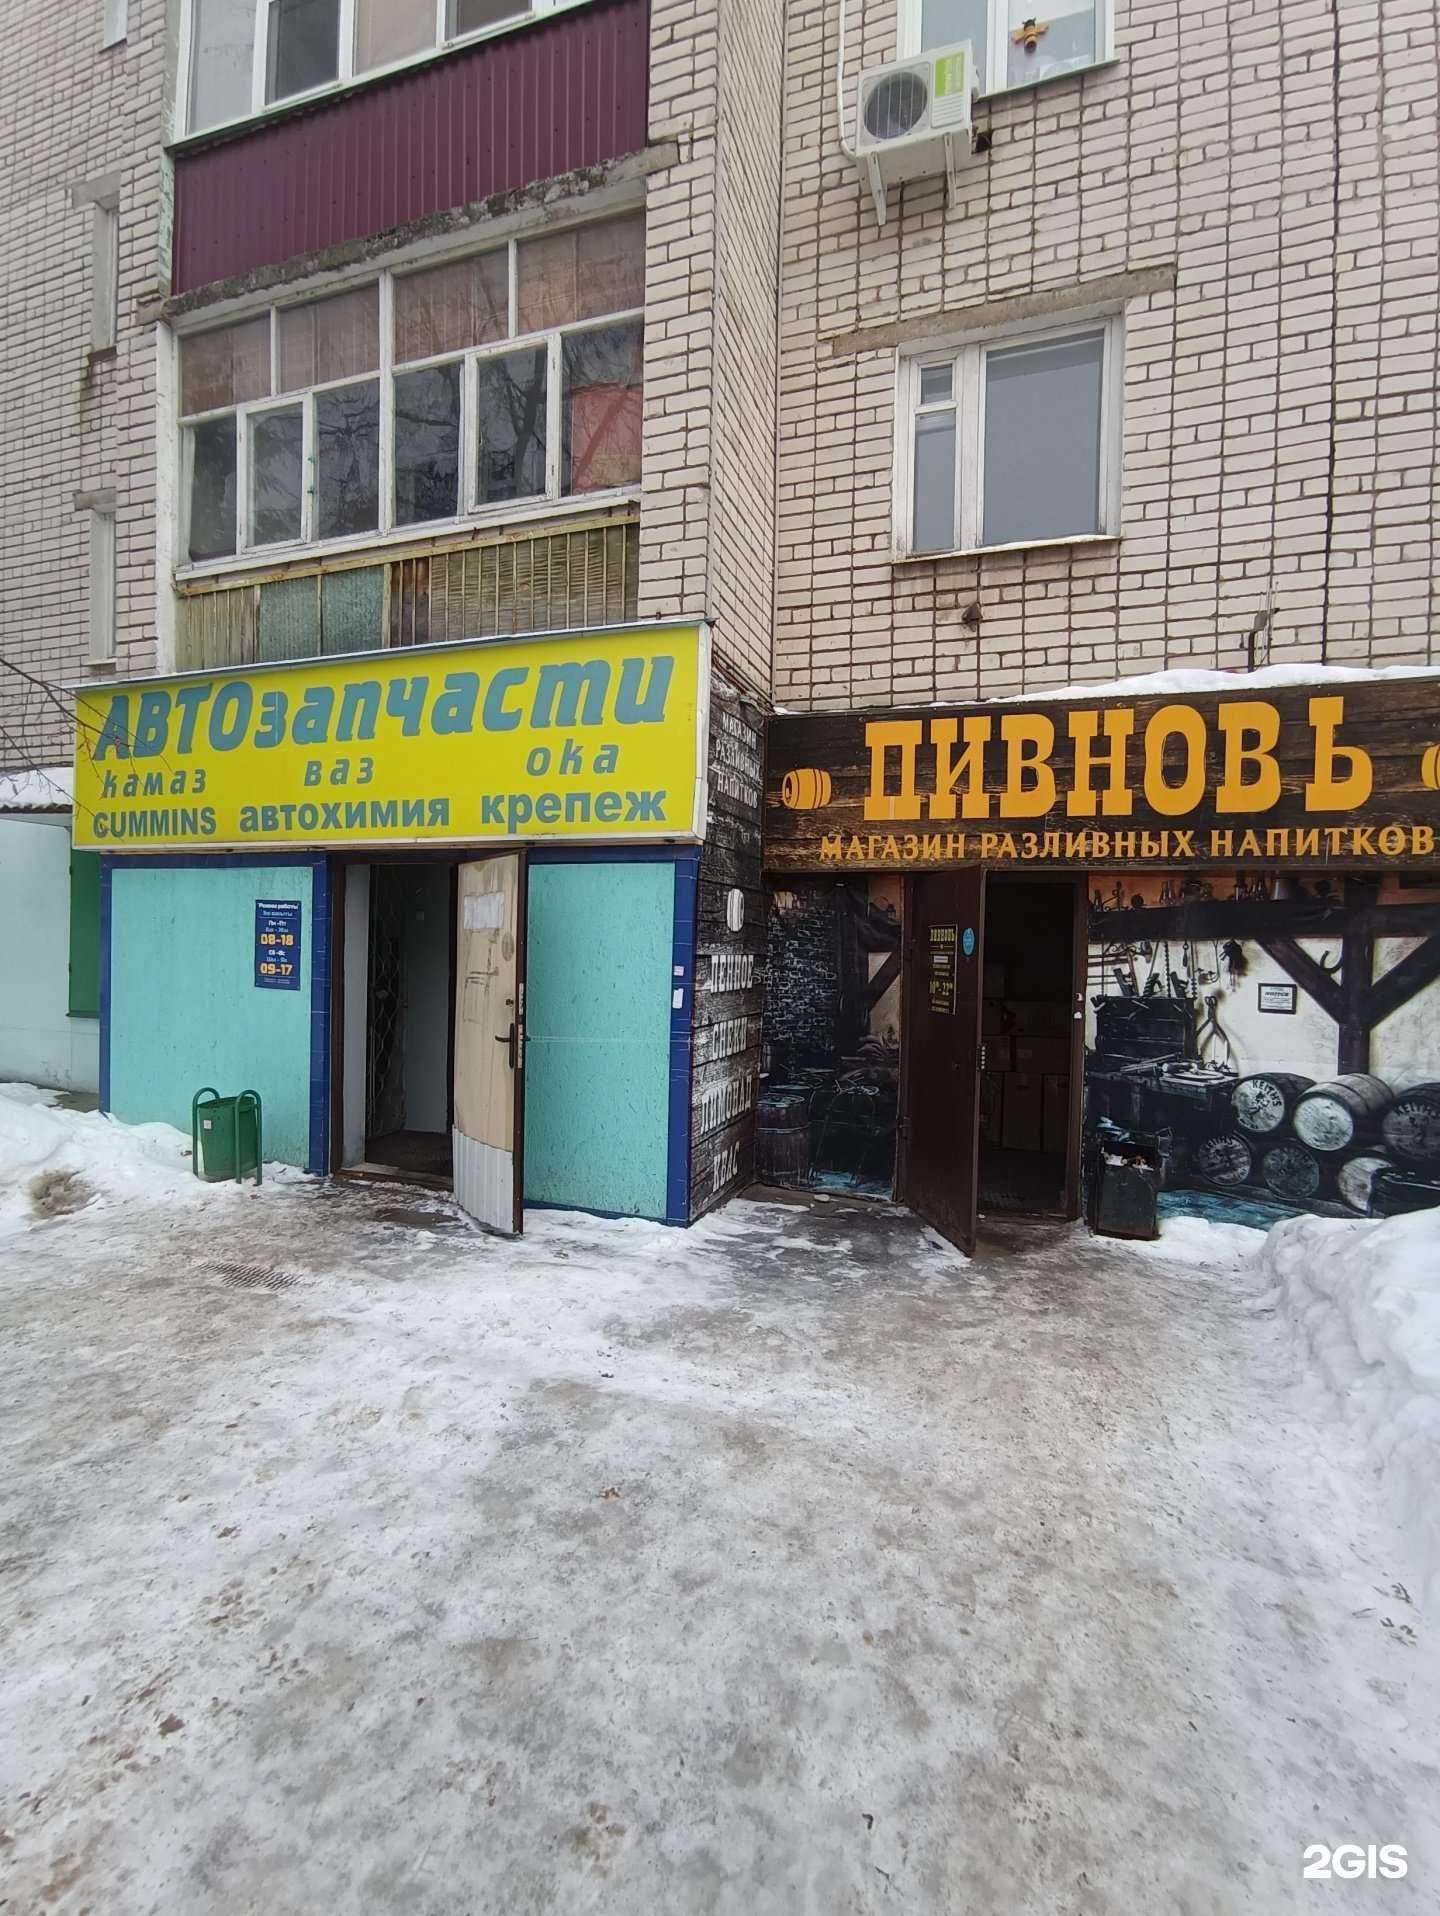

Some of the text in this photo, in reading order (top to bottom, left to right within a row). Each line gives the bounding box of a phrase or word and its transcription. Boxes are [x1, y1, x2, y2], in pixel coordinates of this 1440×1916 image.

[93, 656, 674, 761] АВТОзапчасти
[721, 711, 757, 751] МАГАЗИН
[304, 757, 374, 787] ваз
[715, 738, 761, 782] РАЗЛИВНЫХ
[717, 770, 758, 809] НАПИТКОВ
[92, 789, 667, 838] CUMMINS автохимия крепеж
[820, 826, 1434, 861] МАГАЗИН РАЗЛИВНЫХ НАПИТКОВ
[260, 934, 294, 946] 08-18
[260, 963, 293, 976] 09-17
[710, 954, 754, 993] ПЕННОЕ
[712, 1016, 748, 1061] СНЕКИ
[700, 1074, 752, 1136] ЛИМОНАД
[712, 1140, 740, 1193] КВАС
